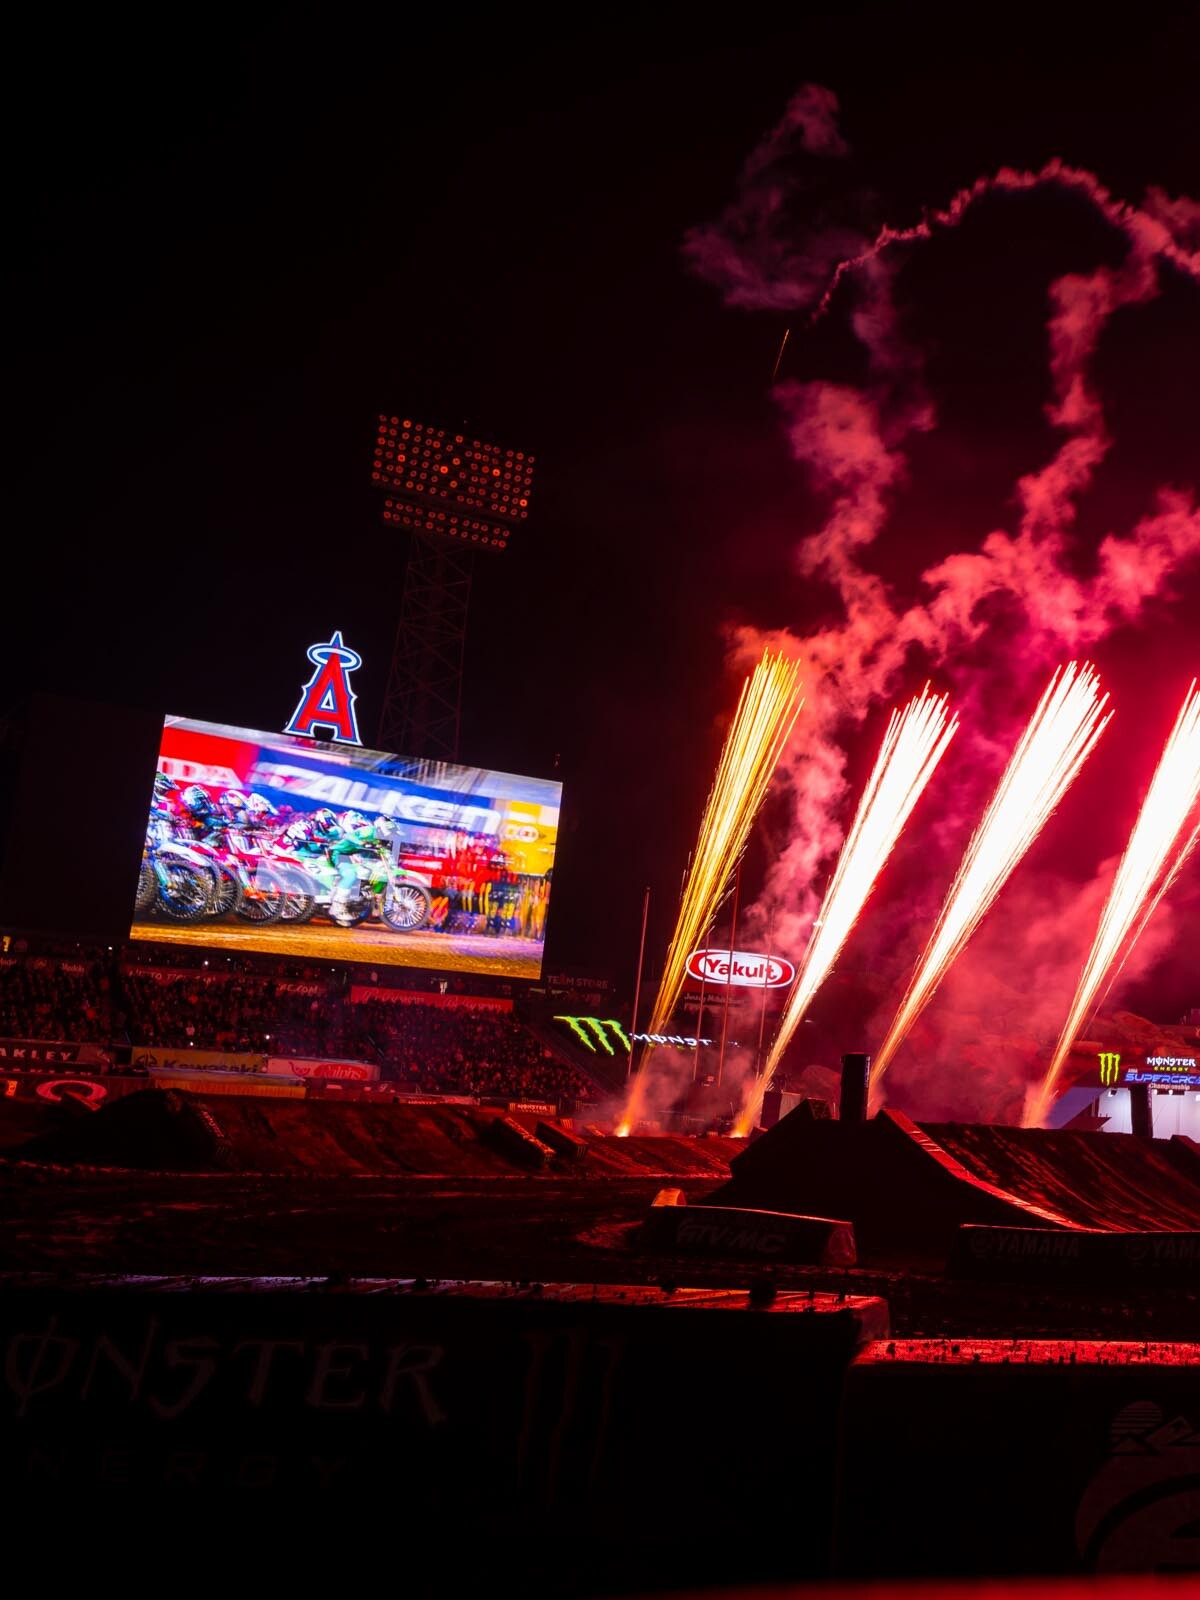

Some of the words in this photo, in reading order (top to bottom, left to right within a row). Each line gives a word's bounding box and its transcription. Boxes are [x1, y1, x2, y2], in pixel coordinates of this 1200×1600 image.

[282, 631, 362, 746] A
[706, 958, 778, 979] Yakult
[547, 975, 575, 986] TEAM
[577, 978, 609, 990] STORE
[319, 1064, 366, 1079] Ralphs
[995, 1231, 1081, 1258] YAMAHA
